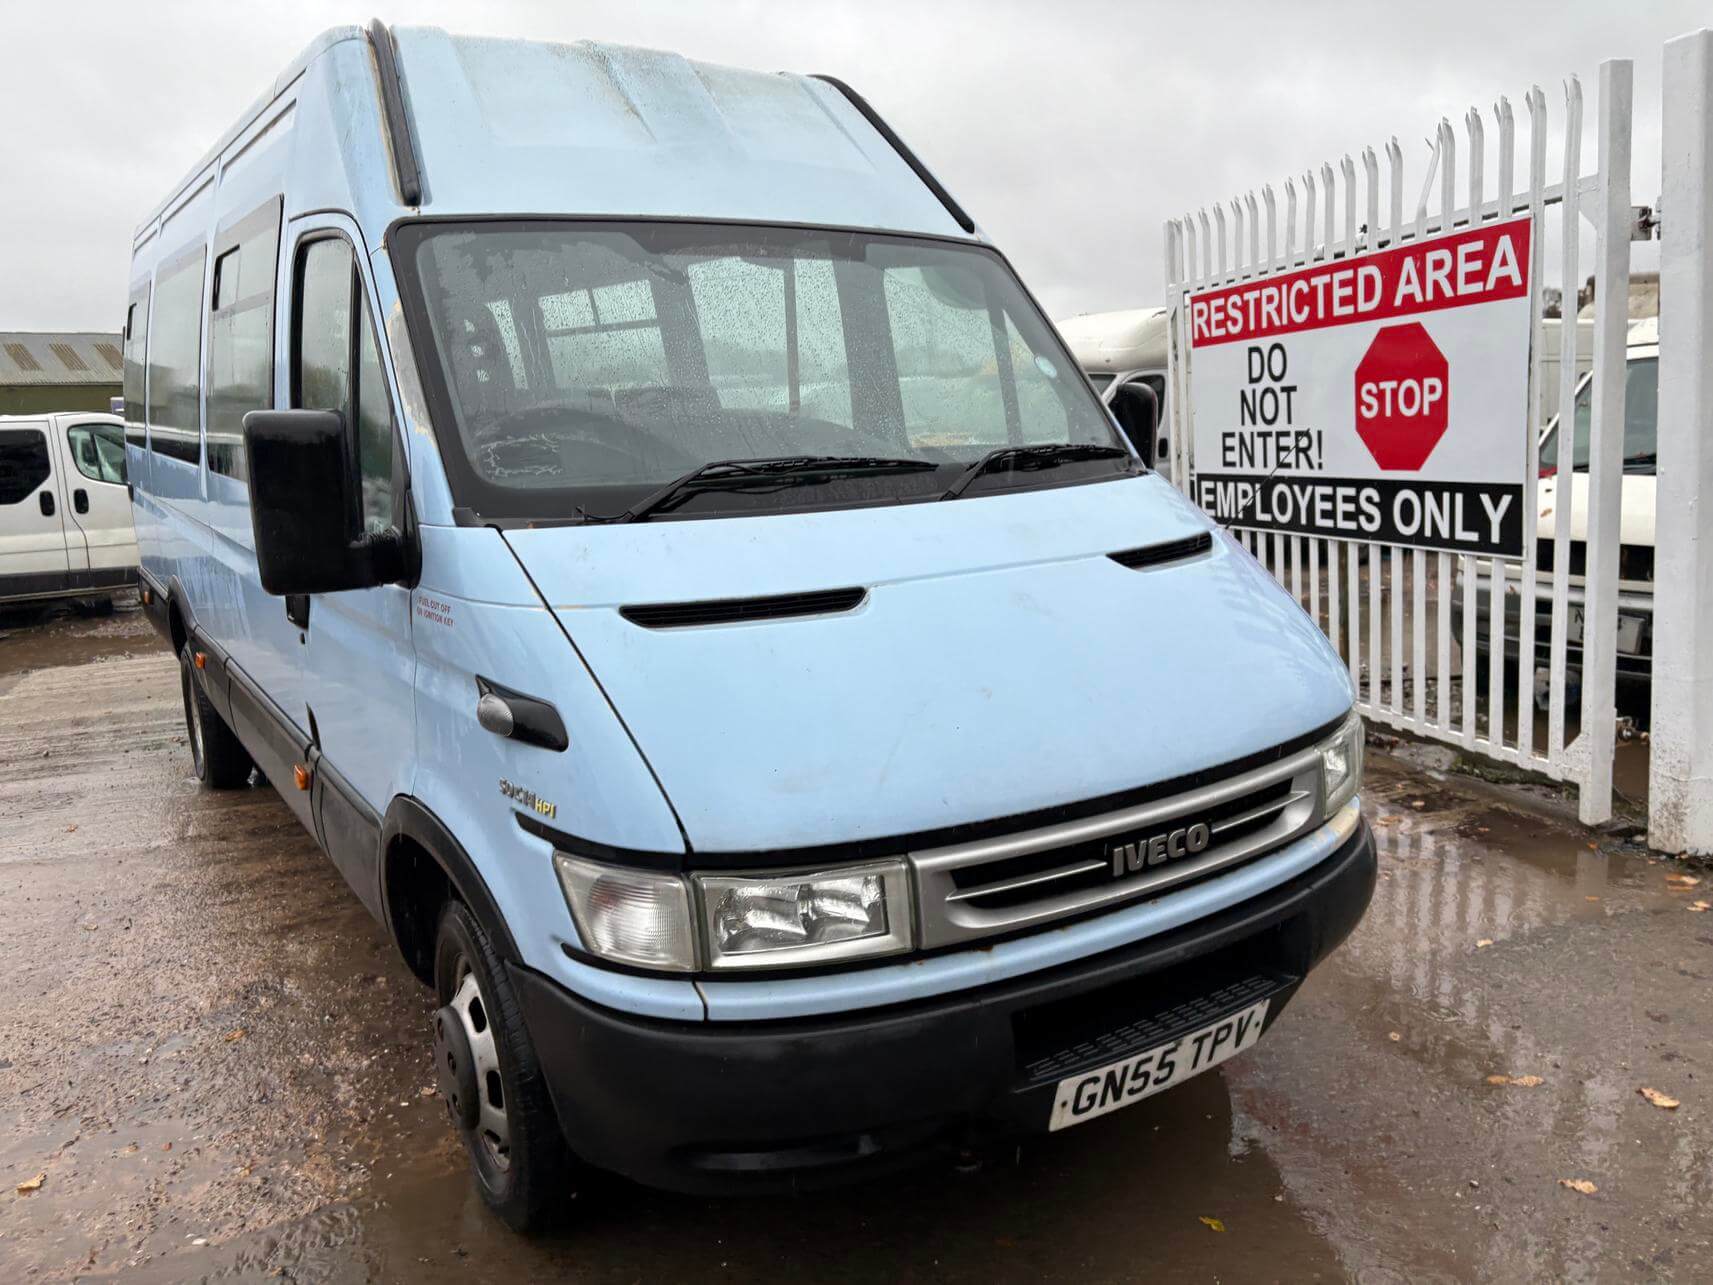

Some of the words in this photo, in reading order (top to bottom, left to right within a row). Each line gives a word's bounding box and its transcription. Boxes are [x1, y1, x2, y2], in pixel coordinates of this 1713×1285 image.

[1192, 264, 1382, 340] RESTRICTED
[1394, 234, 1522, 307] AREA
[1247, 342, 1287, 384] DO
[1240, 386, 1297, 426] NOT
[1360, 377, 1443, 418] STOP
[1221, 430, 1323, 470] ENTER!
[1200, 480, 1381, 532] EMPLOYEES
[1393, 489, 1512, 544] ONLY
[535, 798, 556, 819] HPI
[1113, 823, 1210, 877] IVECO
[1071, 1045, 1178, 1117] GN55
[1190, 1010, 1256, 1068] TPV
